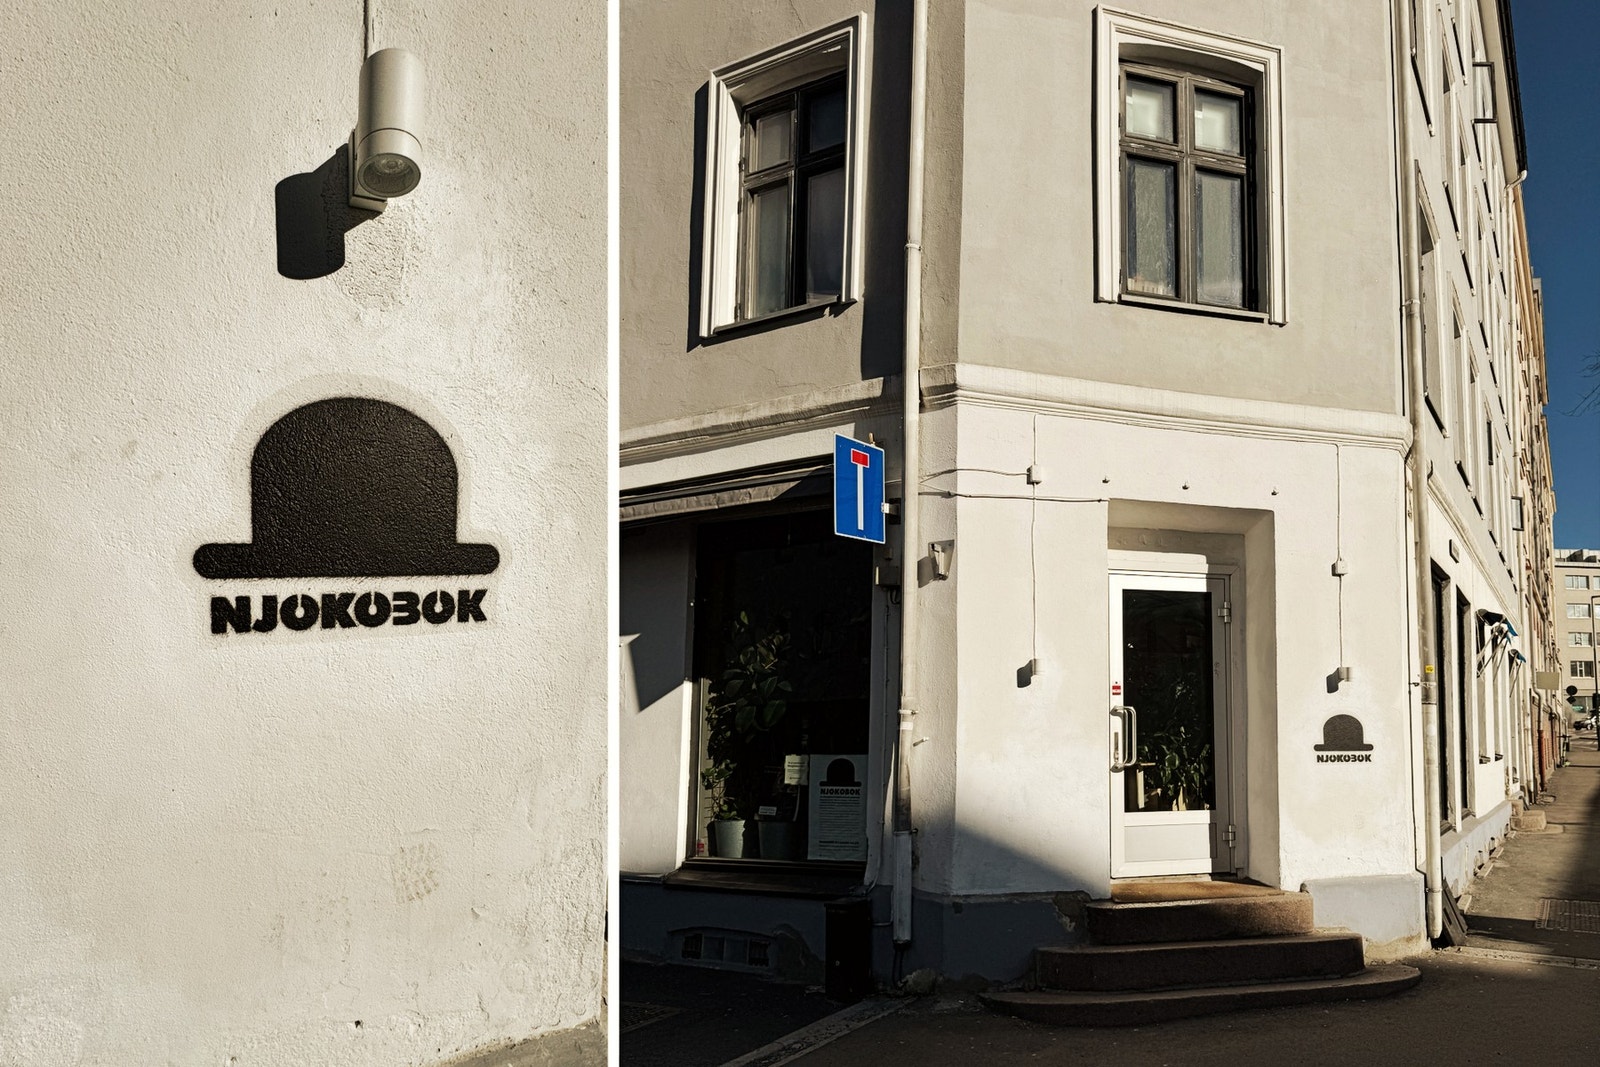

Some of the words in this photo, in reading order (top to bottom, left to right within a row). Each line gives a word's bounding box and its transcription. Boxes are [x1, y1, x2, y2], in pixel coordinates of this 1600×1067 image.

[210, 589, 488, 634] NJOKOBOK
[1316, 754, 1372, 763] NJOKOBOK
[820, 788, 861, 796] NJOKOBOK
